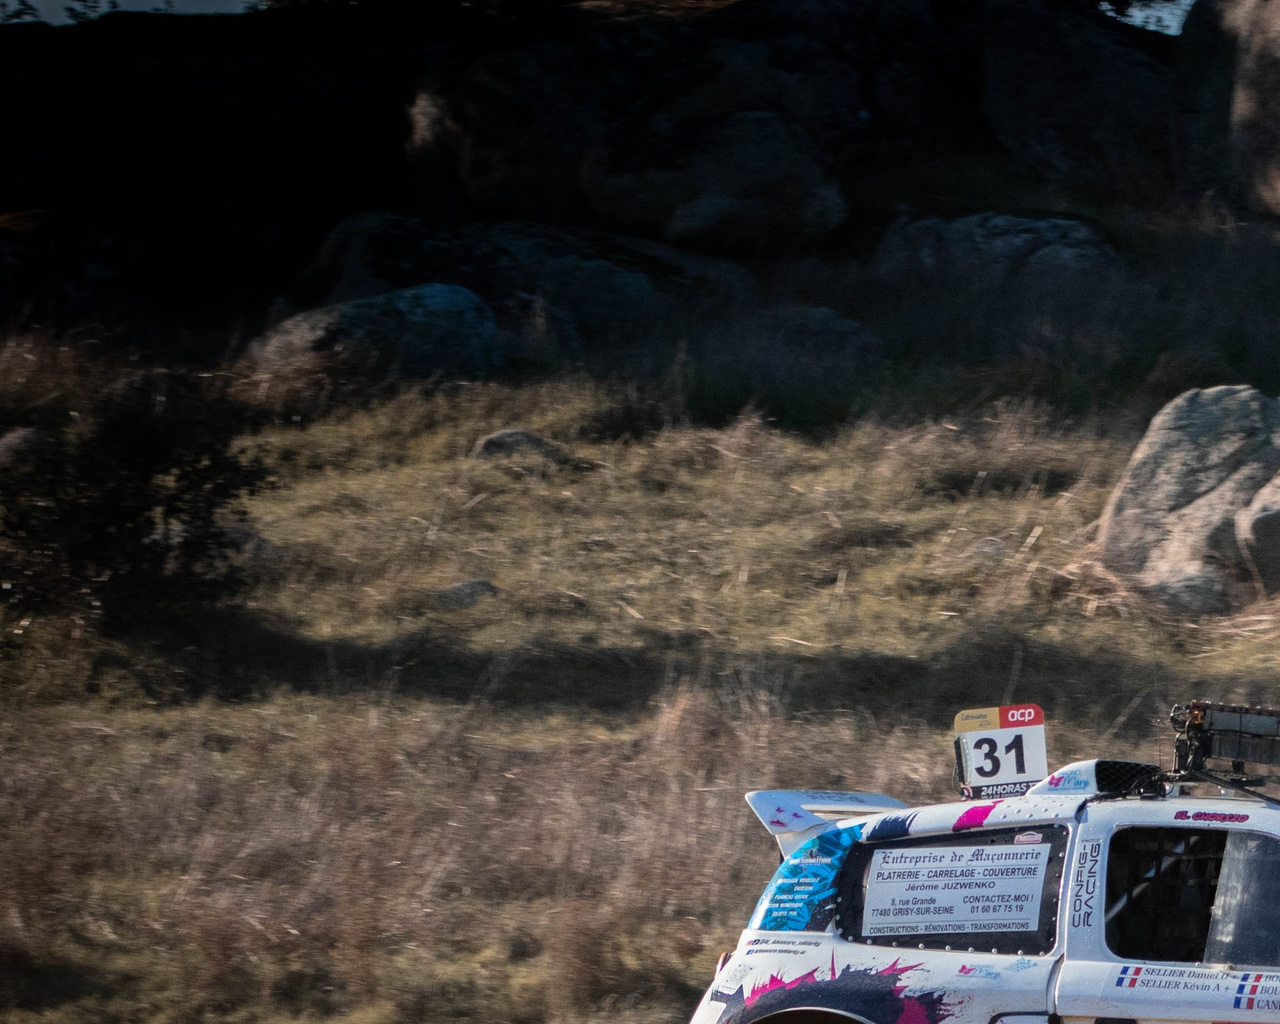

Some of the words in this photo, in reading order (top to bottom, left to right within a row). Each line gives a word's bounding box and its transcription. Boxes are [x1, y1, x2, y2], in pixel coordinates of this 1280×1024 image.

[1008, 708, 1034, 722] acp
[973, 734, 1026, 778] 31
[1174, 810, 1190, 820] EL
[1192, 812, 1250, 822] CHORIZO
[880, 850, 945, 868] Entreprise
[950, 850, 964, 863] de
[966, 848, 1042, 866] Maçonnerie
[876, 870, 920, 881] PLATRERIE
[926, 868, 976, 879] CARRELAGE
[982, 867, 1038, 877] COUVERTURE
[905, 882, 940, 892] Jérôme
[941, 882, 996, 890] JUZWENKO
[1082, 843, 1100, 927] RACING
[891, 898, 897, 906] 8,
[898, 898, 910, 906] rue
[911, 898, 936, 906] Grande
[962, 895, 1029, 904] CONTACTEZ-MOI
[871, 908, 891, 917] 77480
[892, 906, 954, 916] GRISY-SUR-SEINE
[970, 906, 979, 914] 01
[981, 905, 991, 913] 60
[1014, 904, 1024, 912] 19
[869, 925, 920, 934] CONSTRUCTIONS
[924, 923, 966, 932] RÉNOVATIONS
[970, 922, 1029, 931] TRANSFORMATIONS
[1144, 968, 1186, 978] SELLIER
[1187, 970, 1218, 980] Daniel
[1140, 979, 1182, 990] SELLIER
[1183, 982, 1210, 992] Kévin
[1212, 984, 1220, 992] A
